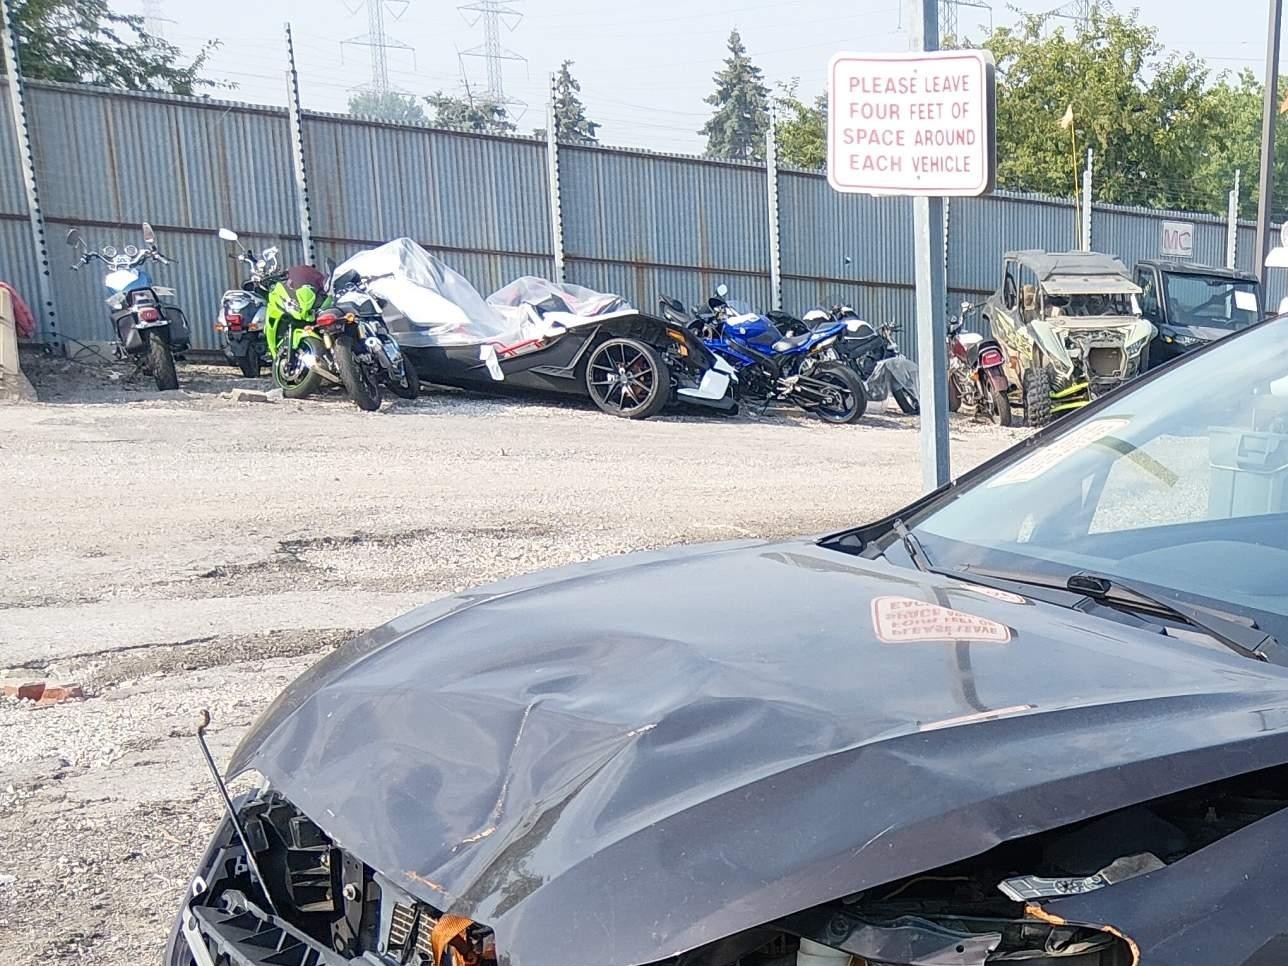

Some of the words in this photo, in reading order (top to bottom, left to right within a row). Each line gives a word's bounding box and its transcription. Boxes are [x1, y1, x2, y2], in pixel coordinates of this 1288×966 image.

[849, 76, 917, 94] PLEASE
[925, 75, 970, 93] LEAVE
[849, 102, 901, 120] FOUR
[910, 102, 944, 120] FEET
[951, 102, 970, 120] OF
[843, 128, 905, 146] SPACE
[914, 128, 976, 146] AROUND
[849, 154, 902, 171] EACH
[912, 155, 971, 172] VEHICLE
[1164, 229, 1191, 250] MC
